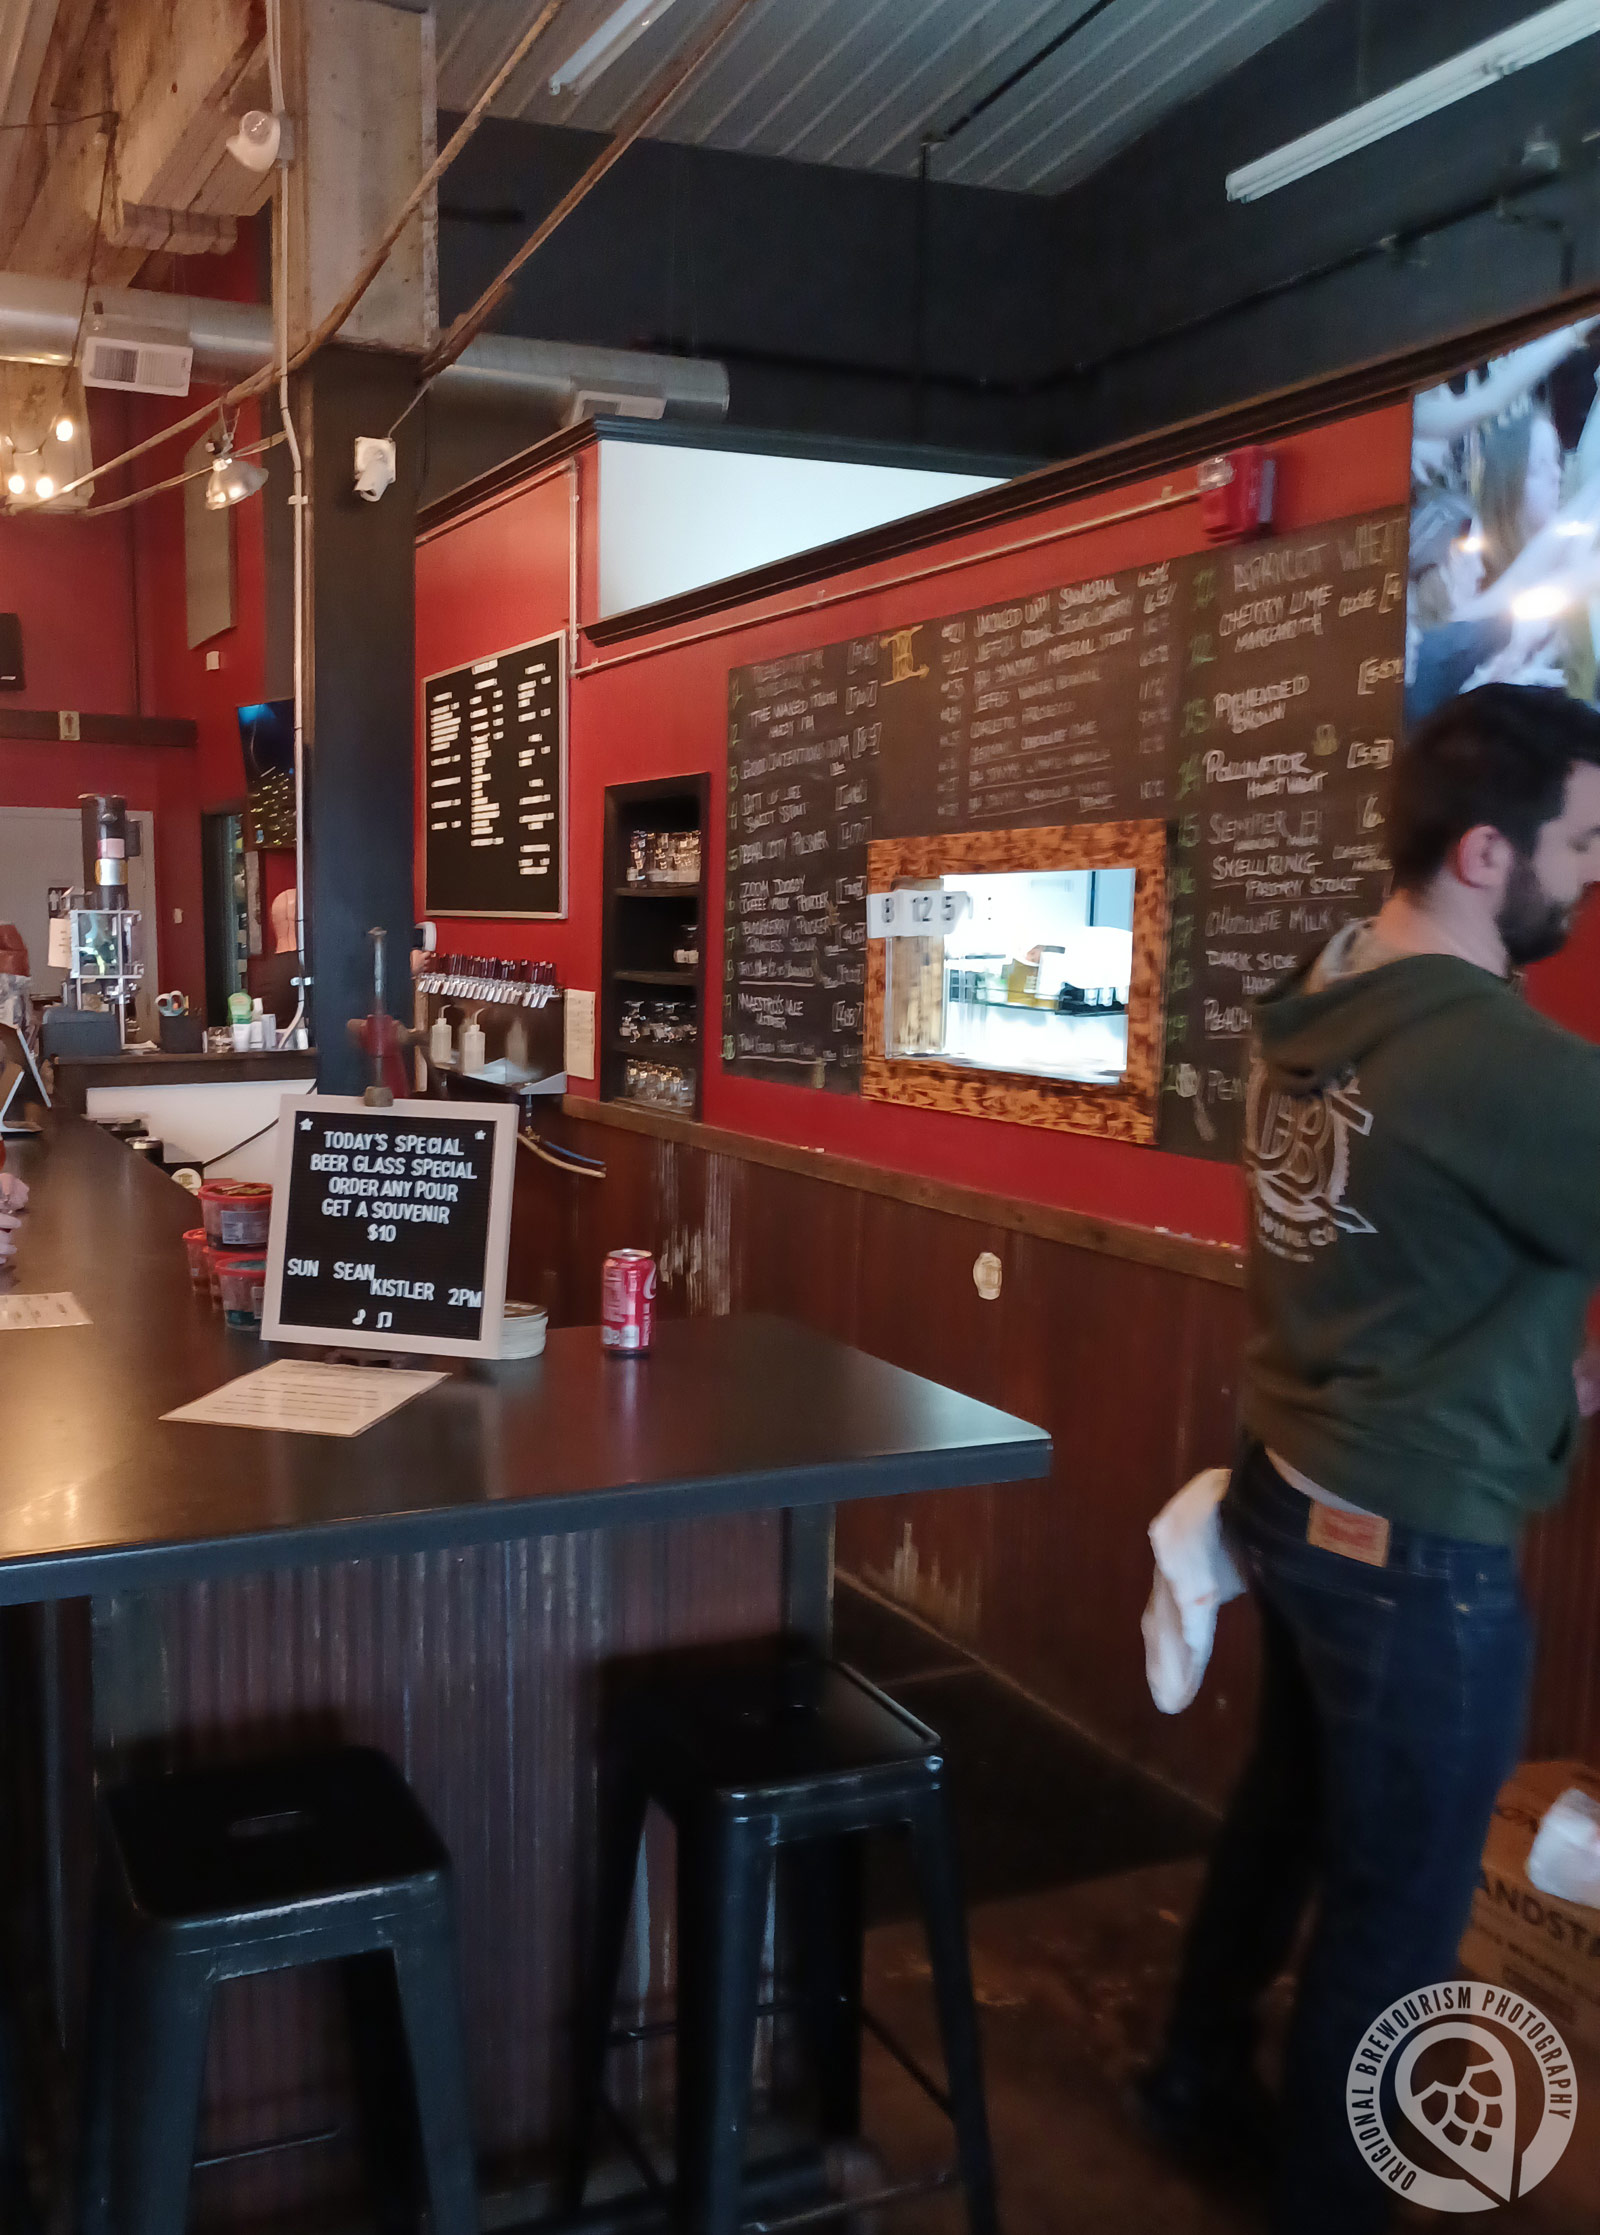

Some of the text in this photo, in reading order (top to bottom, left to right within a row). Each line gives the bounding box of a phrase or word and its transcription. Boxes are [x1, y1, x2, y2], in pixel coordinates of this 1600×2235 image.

[881, 897, 896, 923] 8
[324, 1130, 465, 1156] TODAY'S SPECIAL
[310, 1154, 478, 1180] BEER GLASS SPECIAL
[328, 1177, 459, 1202] ORDER ANY POUR
[322, 1198, 450, 1224] GET A SOUVENIR
[367, 1223, 396, 1242] $10
[287, 1258, 375, 1281] SUN SEAN
[370, 1278, 482, 1308] KISTLER 2PM
